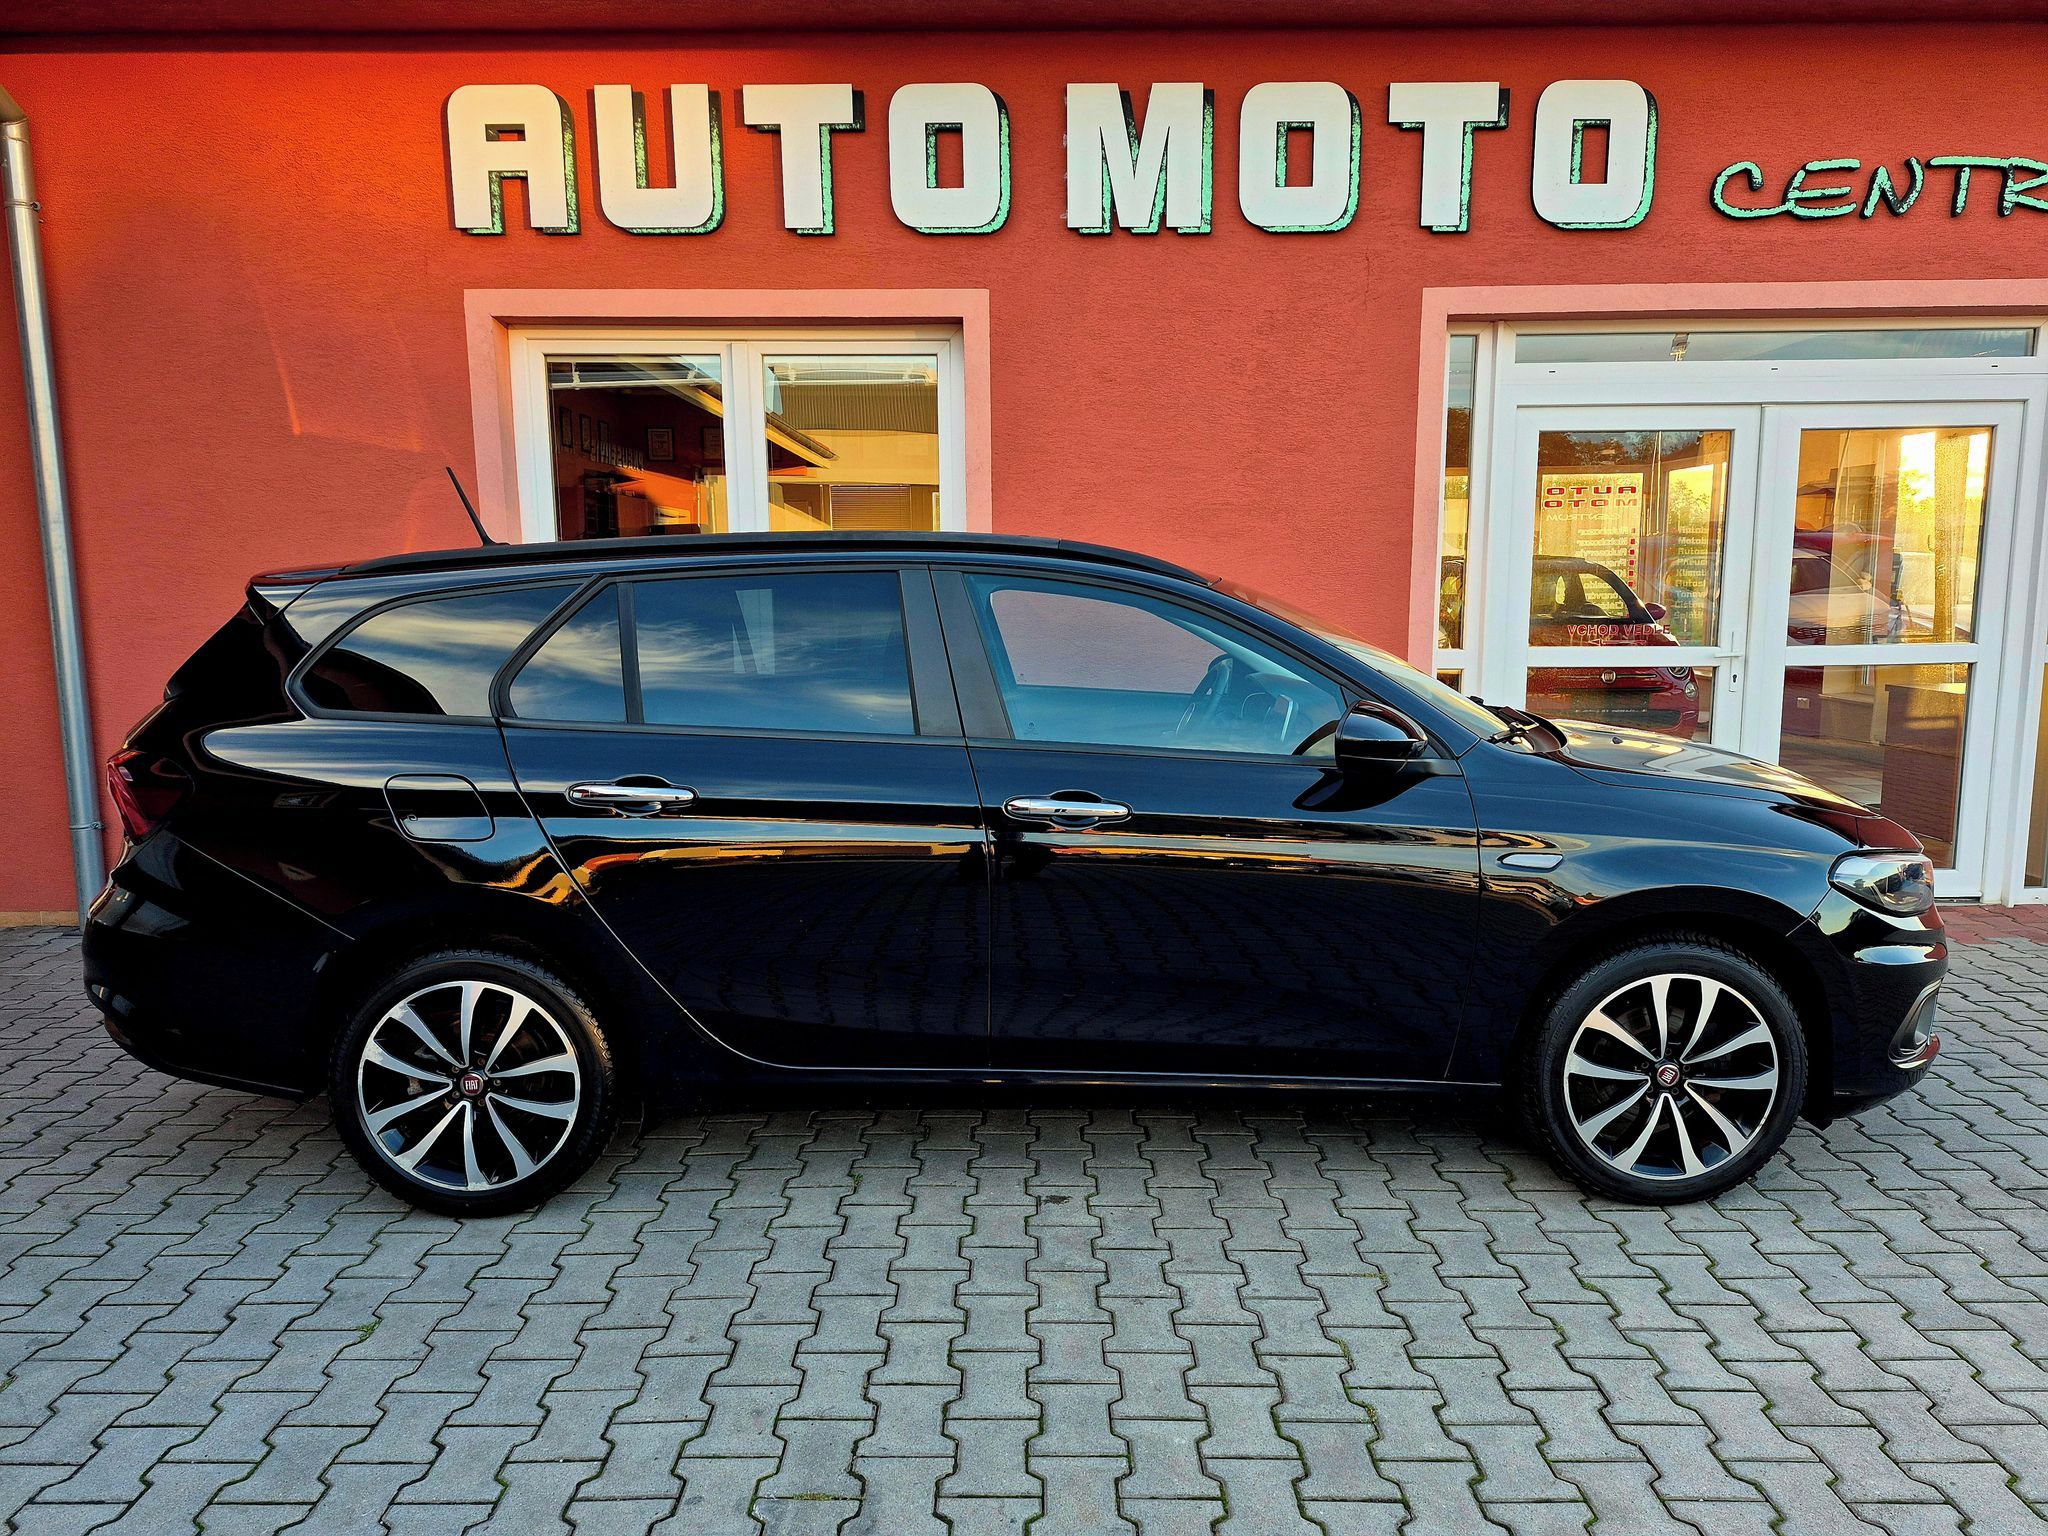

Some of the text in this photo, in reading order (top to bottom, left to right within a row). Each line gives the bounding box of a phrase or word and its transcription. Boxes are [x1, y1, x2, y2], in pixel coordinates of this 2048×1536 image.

[447, 80, 1658, 236] AUTO MOTO
[1711, 156, 2048, 221] CENTR
[1567, 623, 1671, 637] VCHOD VEDLE
[465, 1080, 479, 1090] FIAT
